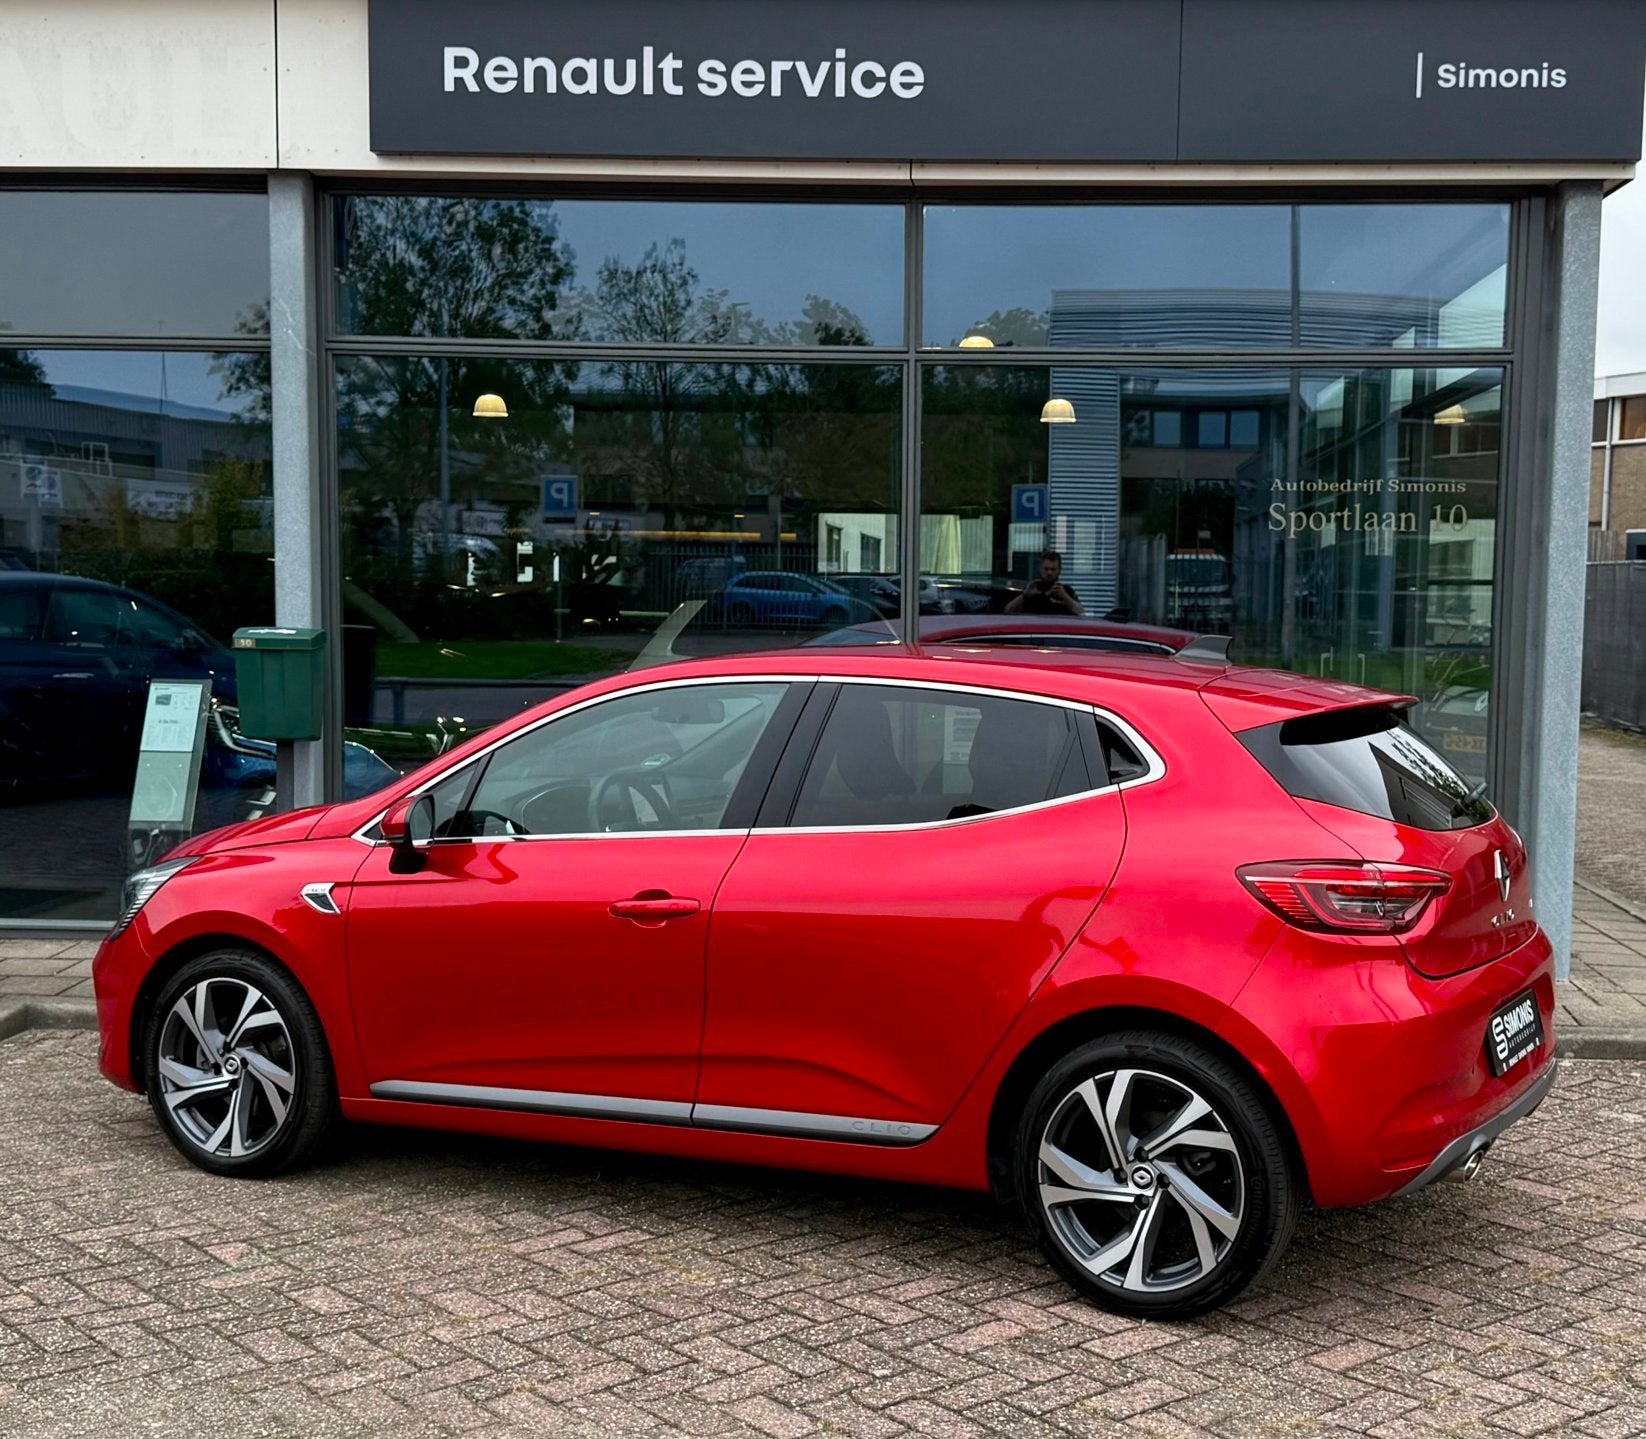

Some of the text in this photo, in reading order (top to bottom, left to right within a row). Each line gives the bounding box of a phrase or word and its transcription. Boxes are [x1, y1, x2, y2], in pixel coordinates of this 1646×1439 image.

[443, 45, 925, 99] Renault service
[1437, 62, 1567, 88] Simonis
[1270, 478, 1467, 495] Autobedrijf Simonis
[1268, 502, 1468, 539] Sportlaan 10
[1503, 999, 1534, 1038] SIMONIS
[851, 1120, 913, 1136] CLIO
